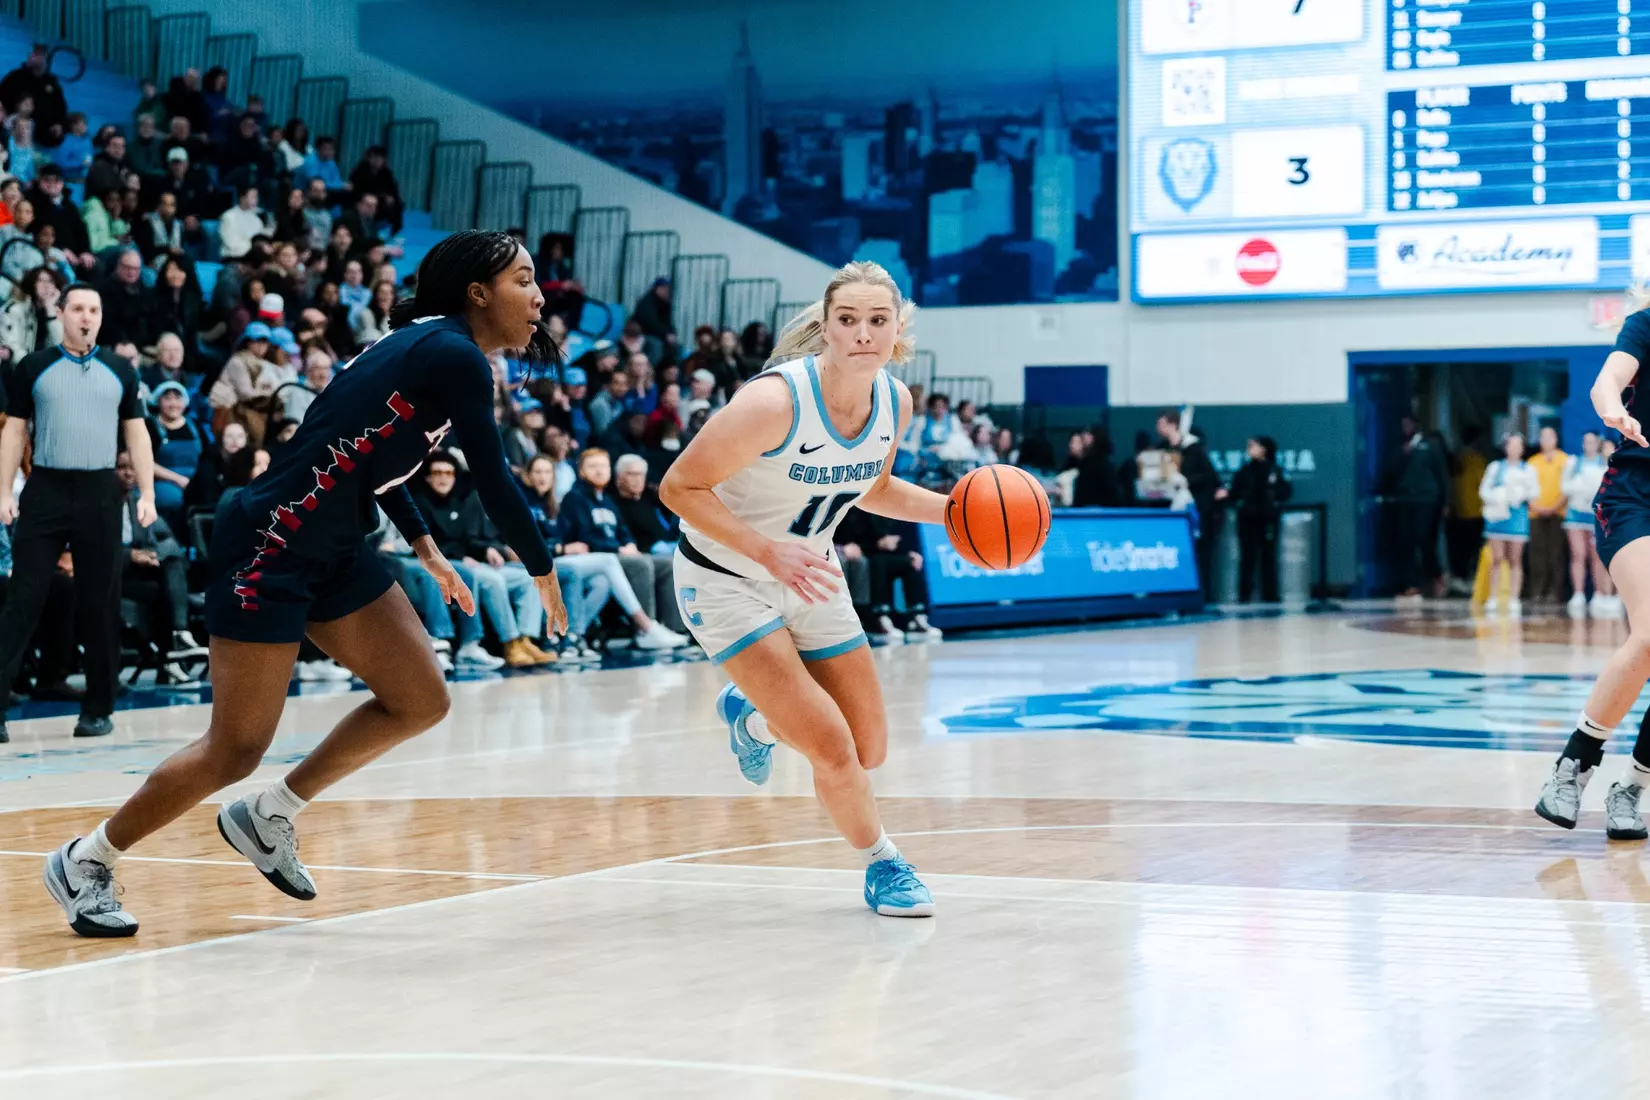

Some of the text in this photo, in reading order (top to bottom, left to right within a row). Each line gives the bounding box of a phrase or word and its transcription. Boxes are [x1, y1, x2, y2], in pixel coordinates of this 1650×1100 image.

[1288, 157, 1310, 185] 3
[1431, 233, 1574, 271] Academy
[788, 457, 885, 485] COLUMBI
